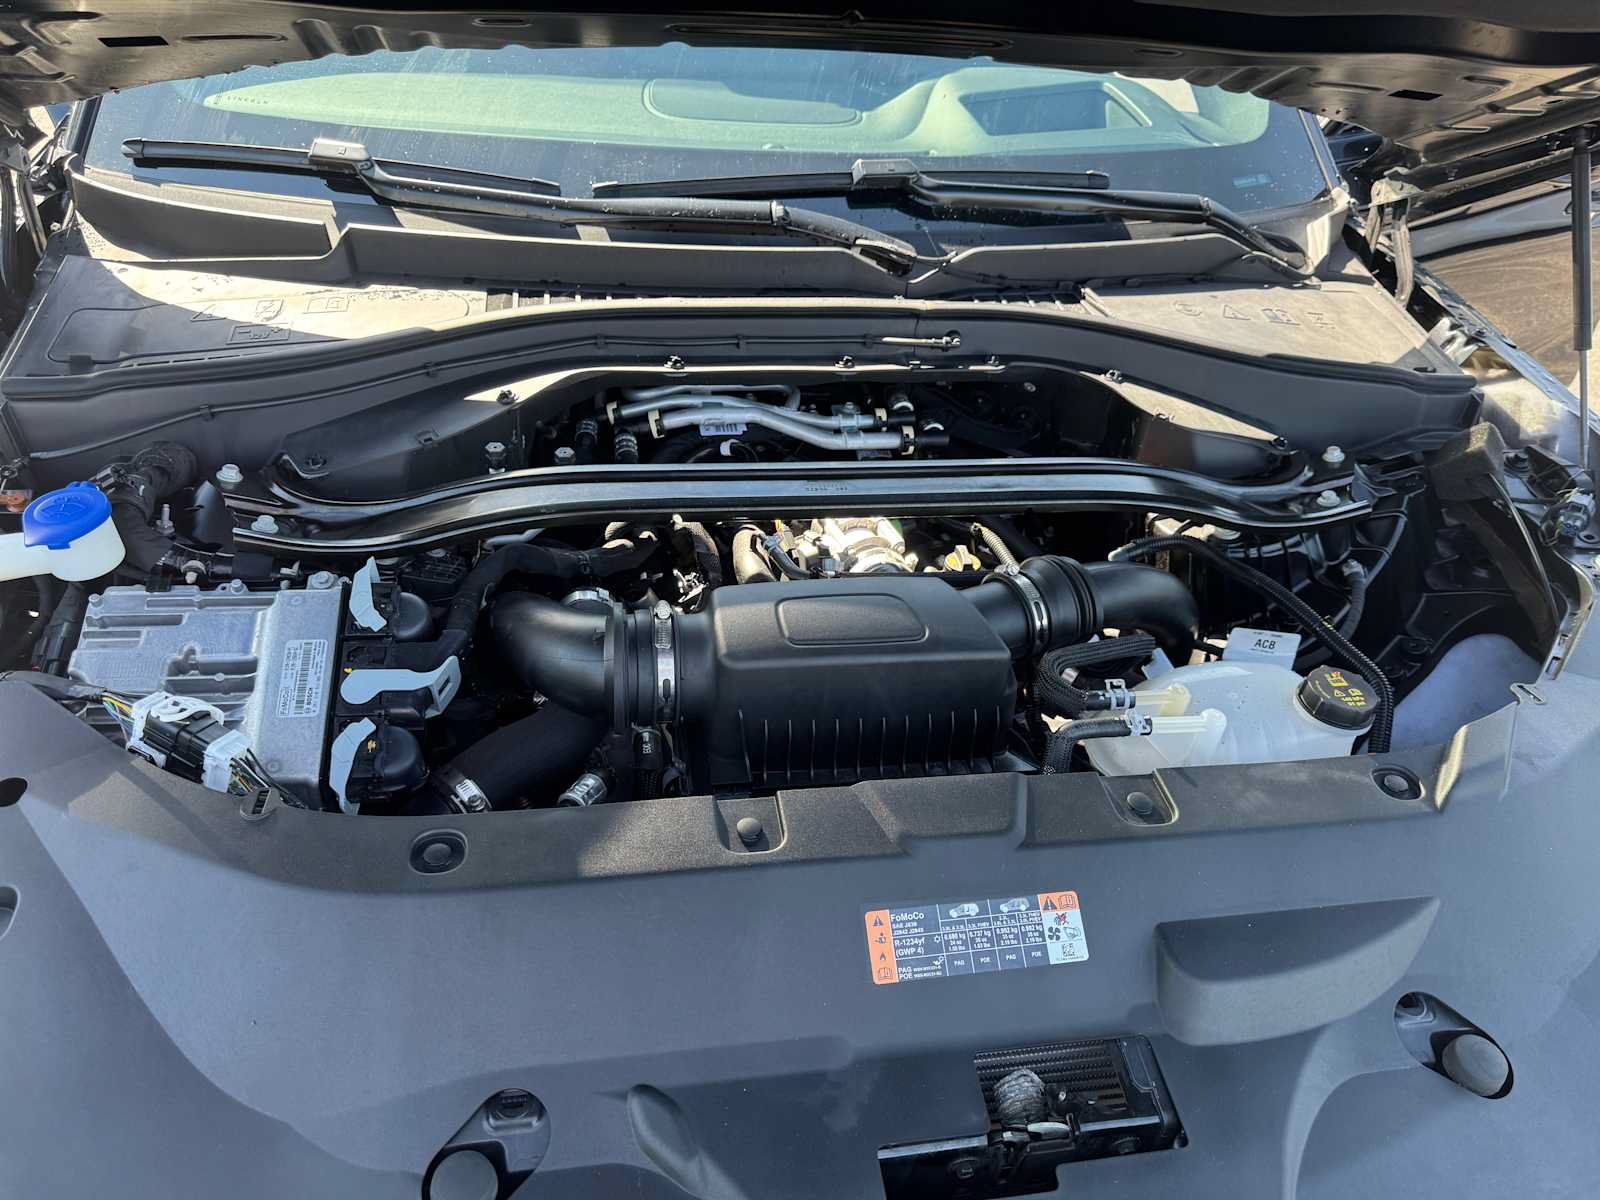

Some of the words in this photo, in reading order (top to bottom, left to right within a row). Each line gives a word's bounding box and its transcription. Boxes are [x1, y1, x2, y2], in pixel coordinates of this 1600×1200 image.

[890, 911, 925, 921] FoMoCo
[894, 937, 925, 947] R-1234yf
[896, 948, 915, 958] (GWP
[917, 947, 925, 955] 4)
